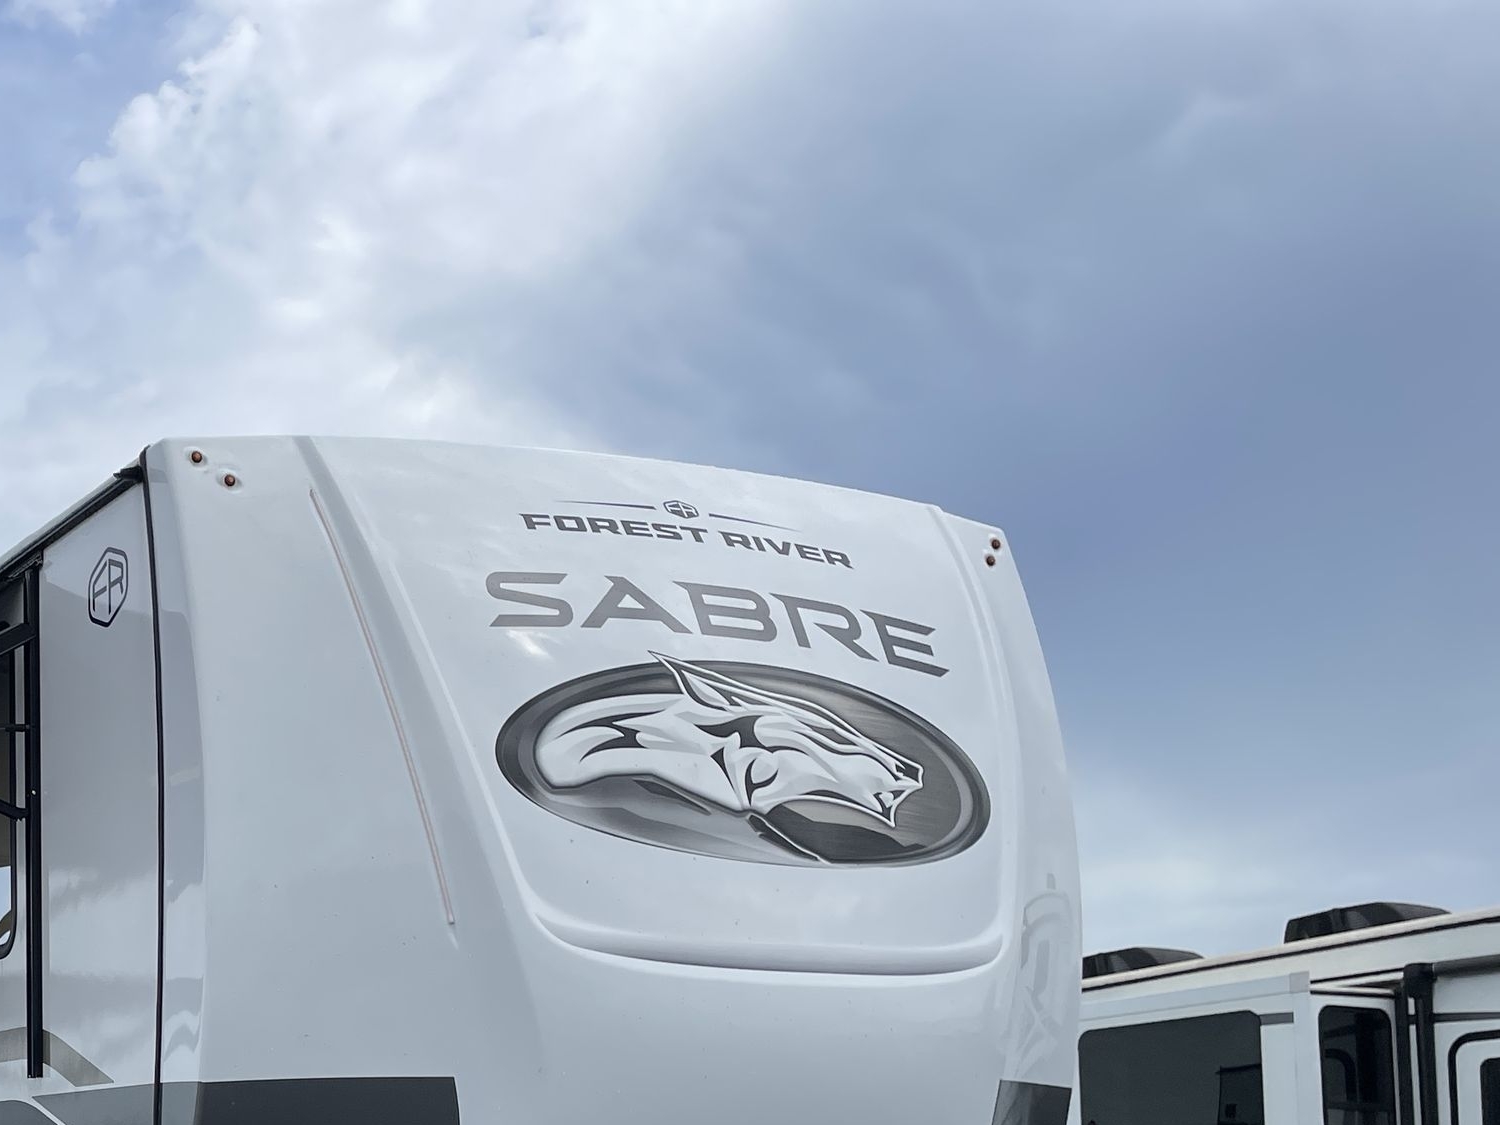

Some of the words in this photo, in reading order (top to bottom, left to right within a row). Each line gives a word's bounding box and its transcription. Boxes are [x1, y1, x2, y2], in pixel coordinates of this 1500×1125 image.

[519, 512, 708, 543] FOREST
[719, 531, 854, 569] RIVER
[486, 571, 950, 678] SABRE
